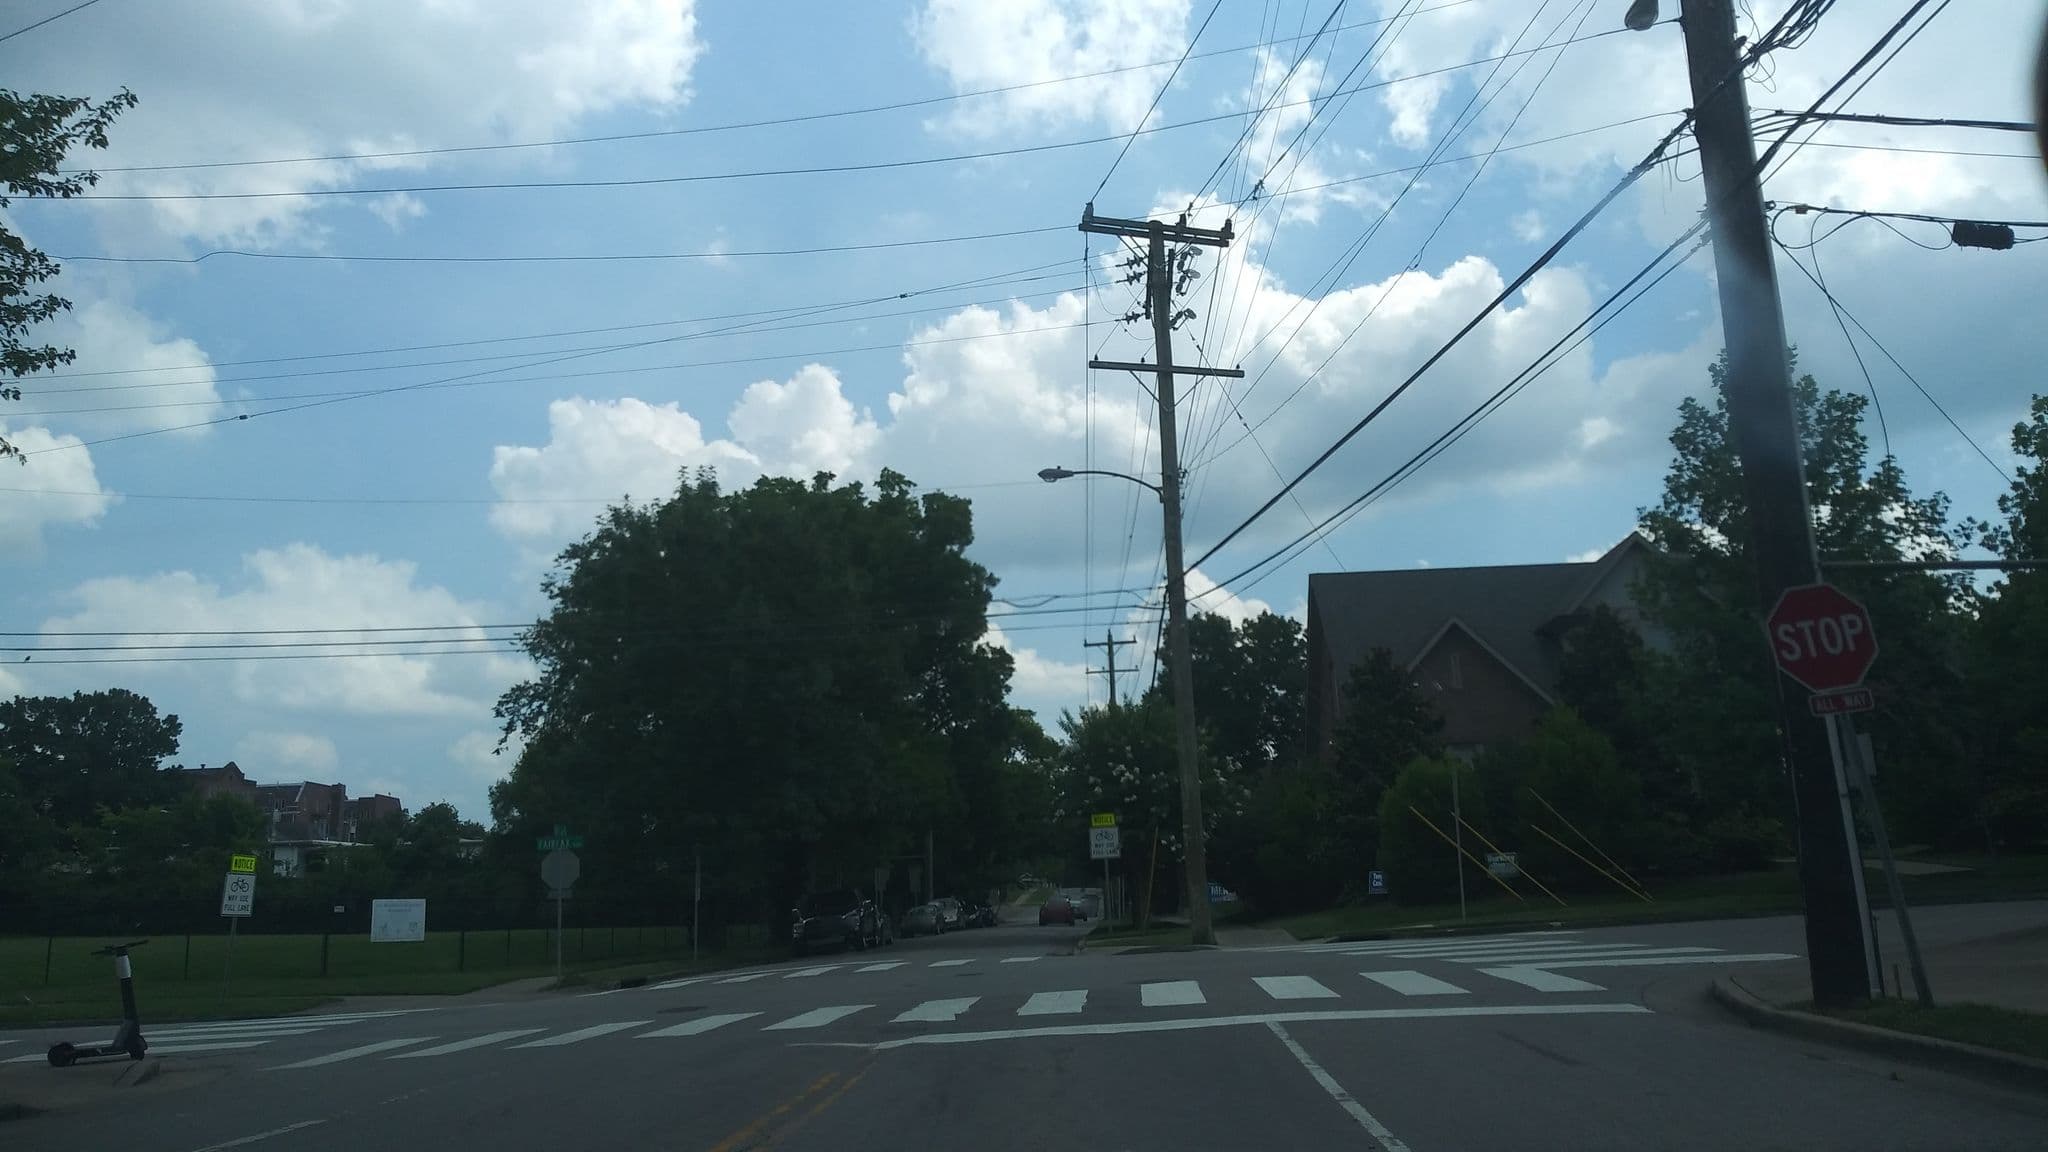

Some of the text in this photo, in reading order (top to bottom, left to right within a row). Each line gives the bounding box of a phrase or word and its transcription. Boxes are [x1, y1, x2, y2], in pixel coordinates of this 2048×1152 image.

[1777, 614, 1863, 661] STOP
[1815, 694, 1870, 712] ALL WAY
[1093, 815, 1113, 825] NOTICE
[233, 858, 255, 869] NOTICE
